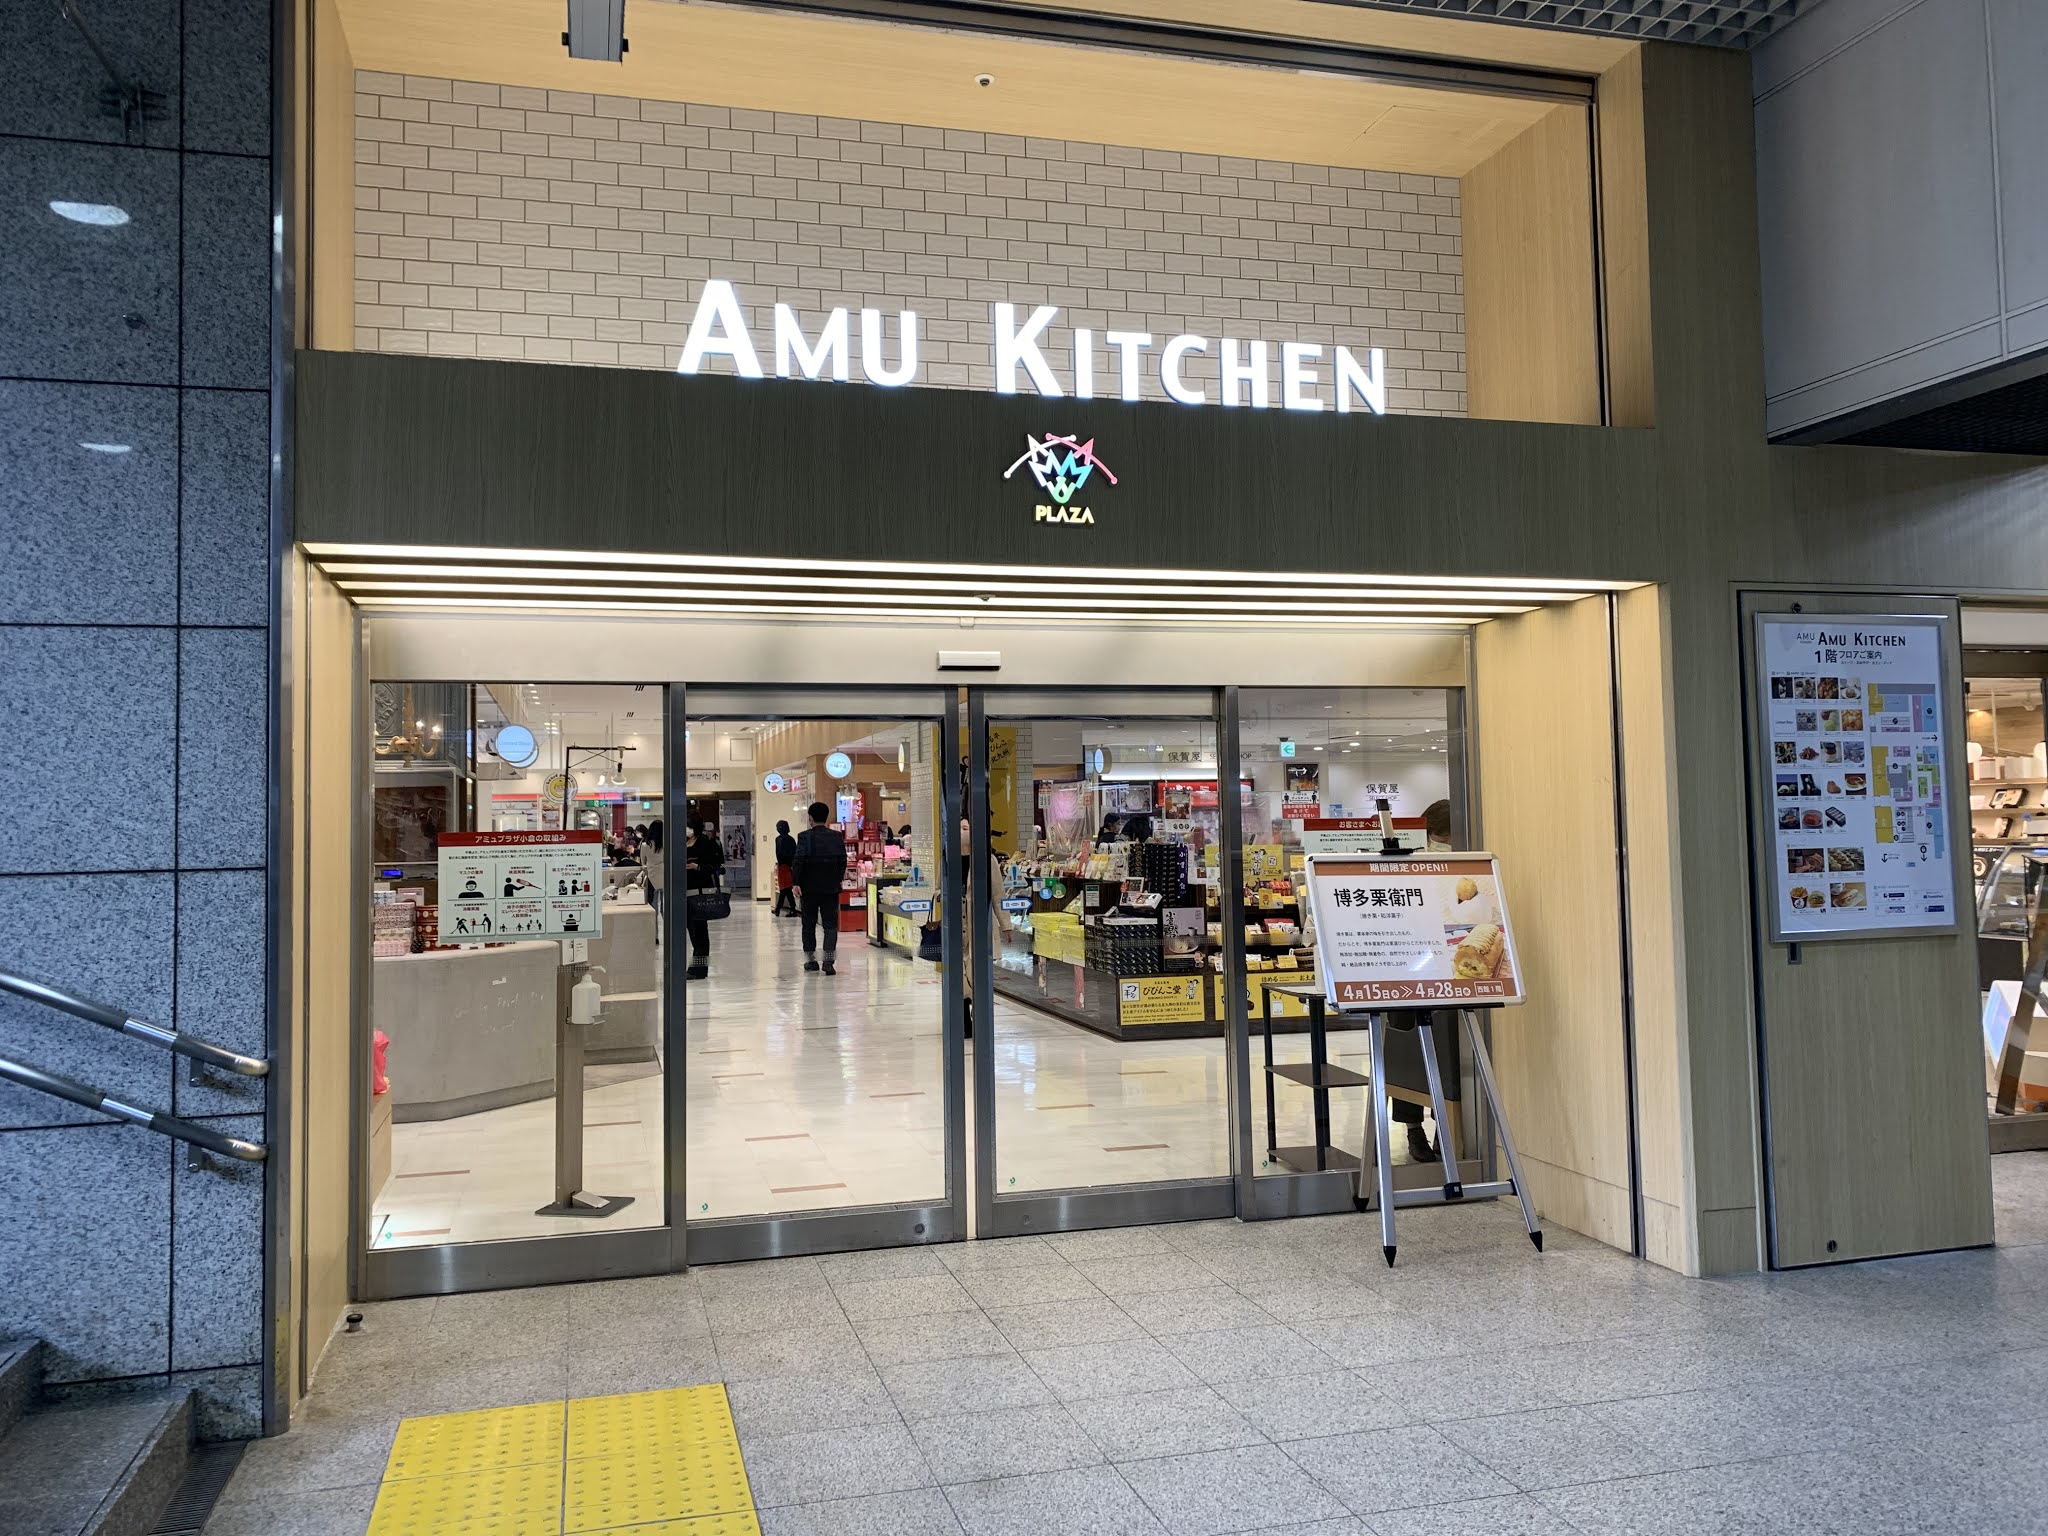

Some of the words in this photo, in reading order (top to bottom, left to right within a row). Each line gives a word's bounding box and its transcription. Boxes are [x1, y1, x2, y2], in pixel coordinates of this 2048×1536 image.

[1035, 504, 1095, 524] PLAZA
[1369, 863, 1410, 873] 期間限定
[1333, 888, 1424, 908] 博多栗衛門
